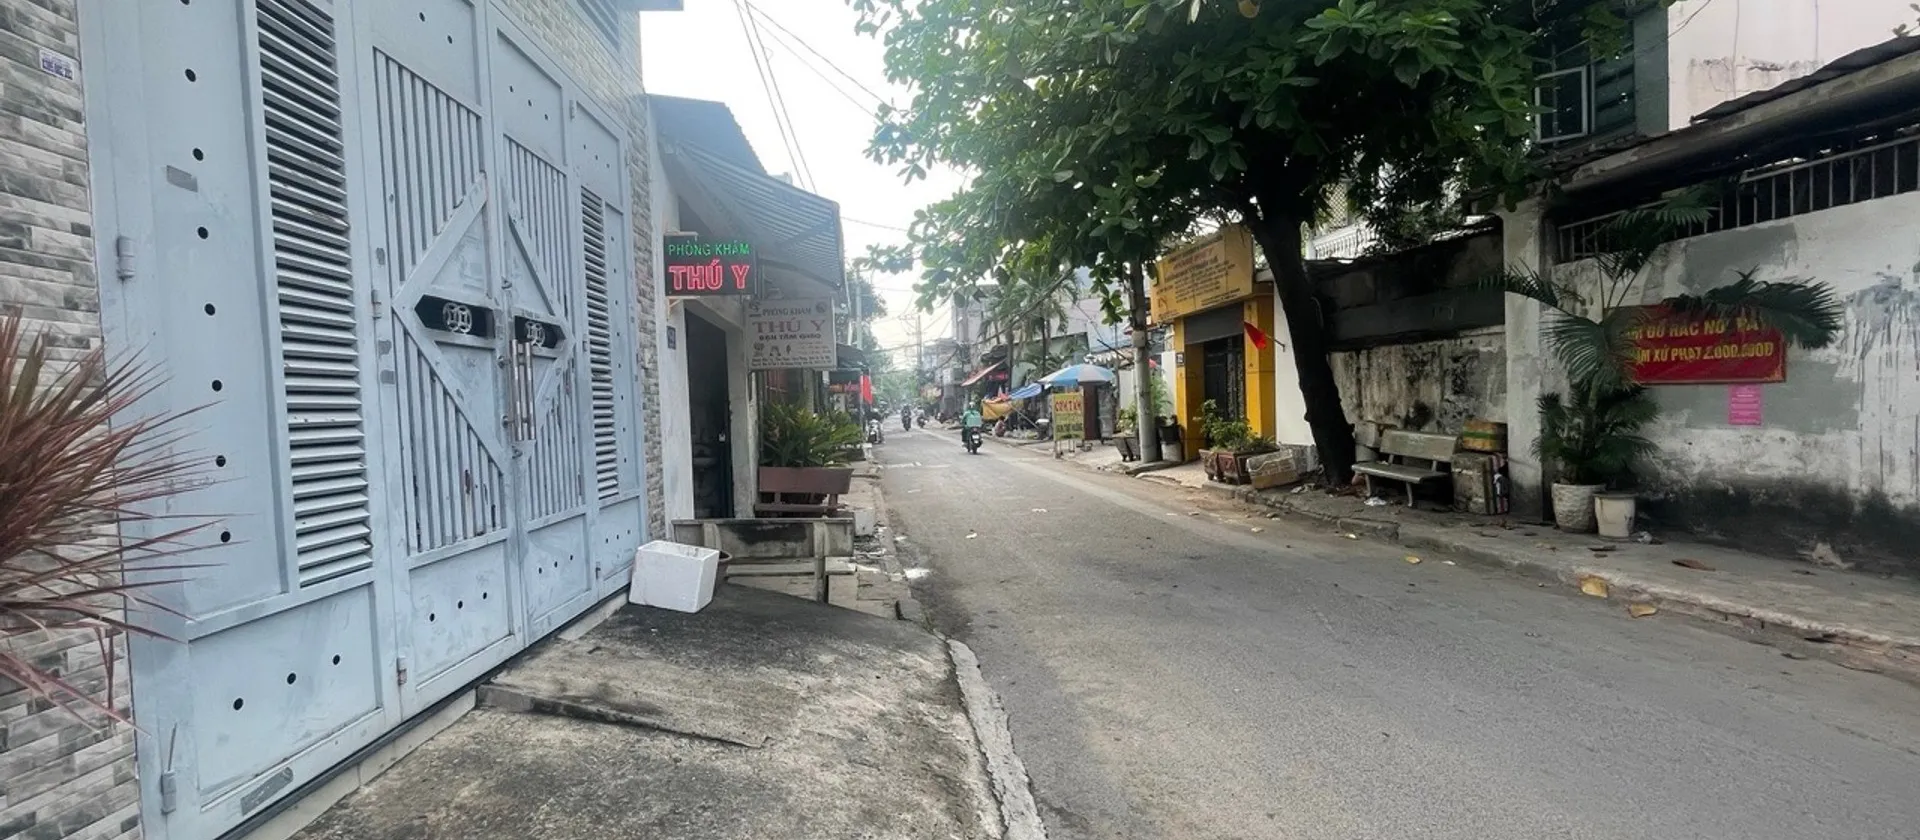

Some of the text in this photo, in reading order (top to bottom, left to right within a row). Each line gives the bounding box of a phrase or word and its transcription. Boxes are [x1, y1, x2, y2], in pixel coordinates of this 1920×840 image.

[669, 240, 750, 256] PHÒNG KHÁM
[668, 258, 750, 290] THÚ Y
[752, 317, 825, 333] THÚ Y
